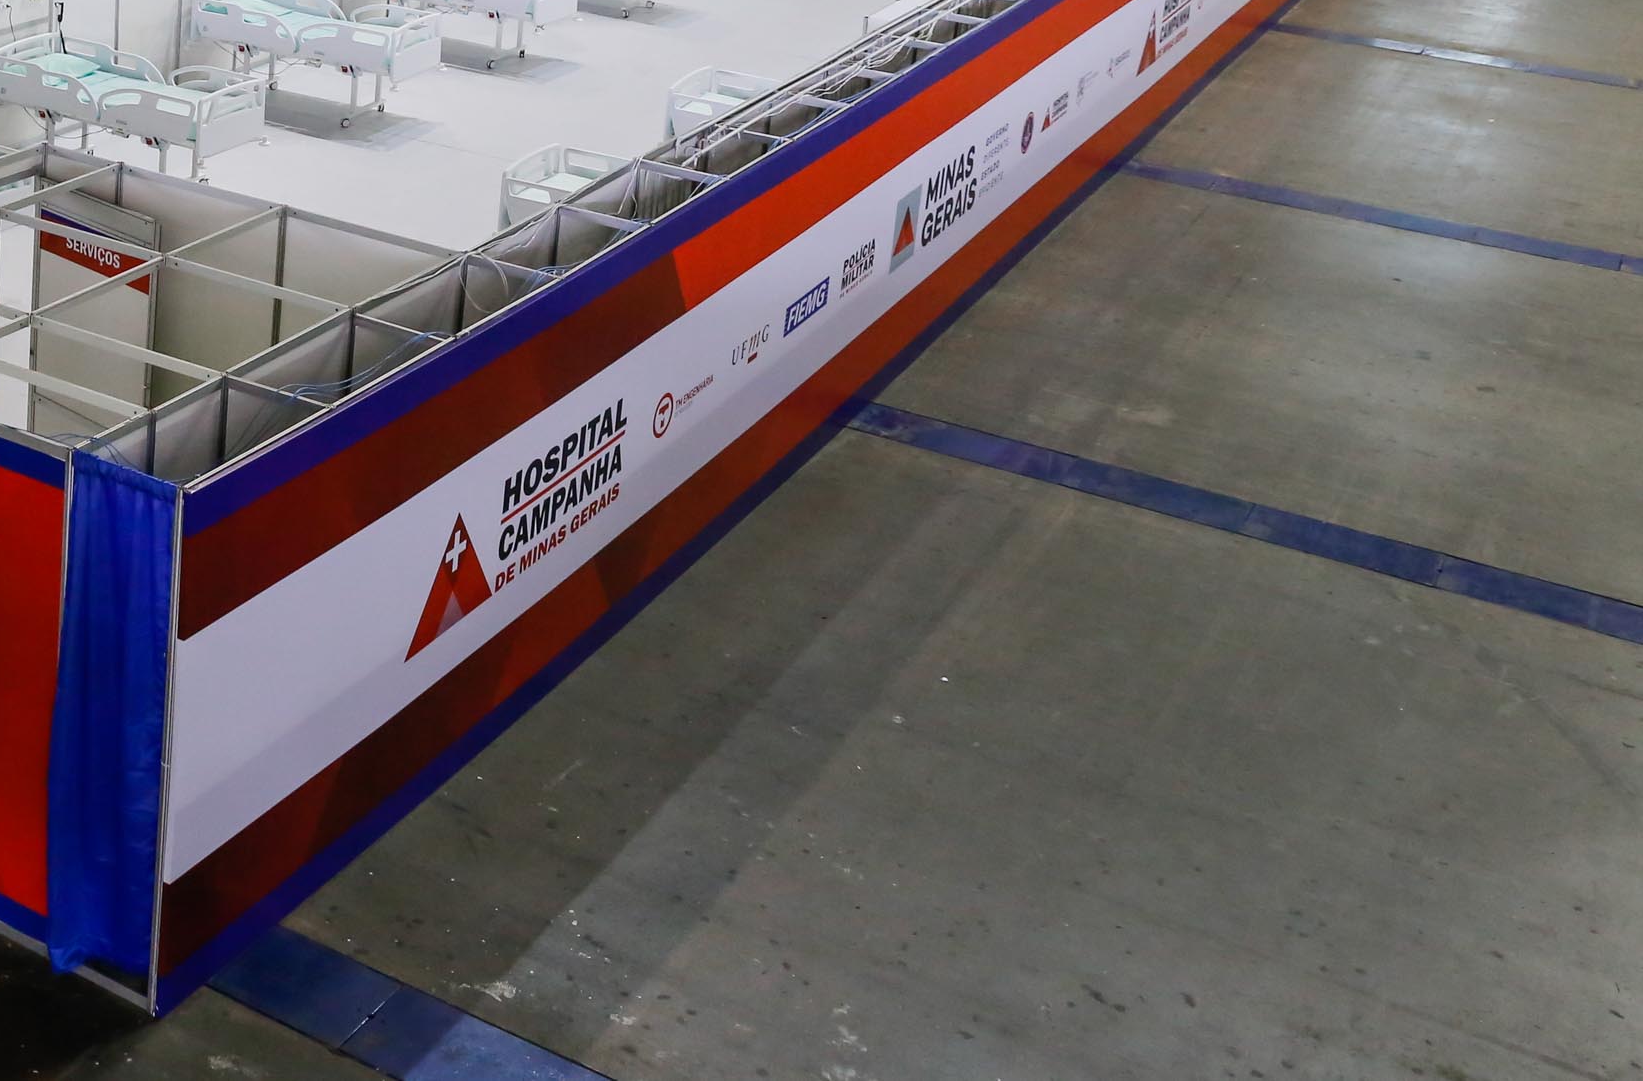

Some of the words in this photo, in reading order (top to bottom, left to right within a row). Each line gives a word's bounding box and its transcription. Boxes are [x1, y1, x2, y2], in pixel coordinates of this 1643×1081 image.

[925, 145, 976, 210] MINAS
[921, 178, 977, 248] GERAIS
[65, 237, 121, 269] SERVIÇOS
[841, 254, 875, 290] MILITAR
[842, 238, 875, 274] POLÍCIA
[786, 283, 828, 332] FIEMG
[731, 324, 770, 366] UFMG
[502, 397, 628, 514] HOSPITAL
[498, 443, 622, 561] CAMPANHA
[494, 562, 516, 594] DE
[519, 526, 567, 575] MINAS
[570, 482, 621, 534] GERAIS
